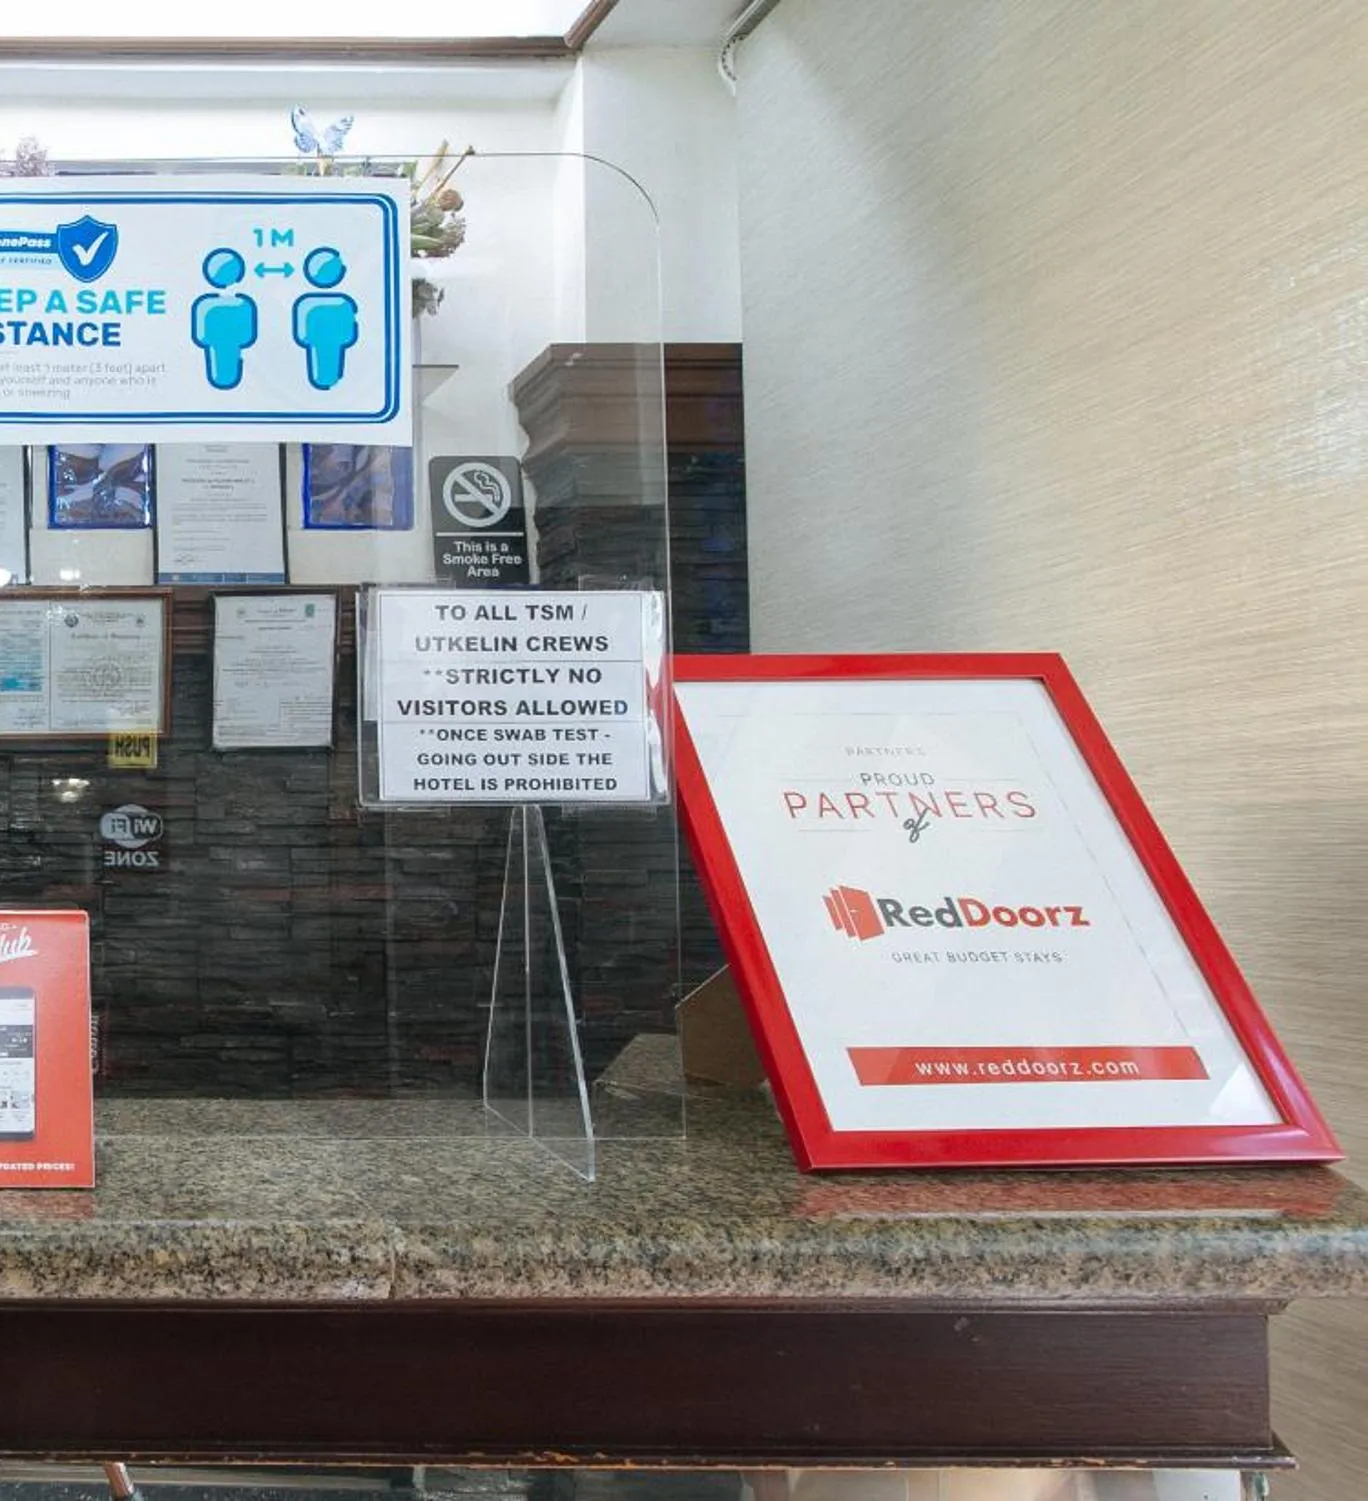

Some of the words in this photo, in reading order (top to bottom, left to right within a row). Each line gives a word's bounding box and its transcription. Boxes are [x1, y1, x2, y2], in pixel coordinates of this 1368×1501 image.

[45, 290, 68, 314] A
[75, 290, 166, 315] SAFE
[453, 541, 483, 552] This
[485, 541, 497, 552] is
[500, 543, 509, 552] a
[442, 553, 489, 565] Smoke
[492, 553, 522, 565] Free
[467, 566, 500, 577] Area
[435, 605, 466, 621] TO
[474, 605, 517, 621] ALL
[525, 605, 574, 621] TSM
[415, 636, 518, 652] UTKELIN
[526, 636, 609, 652] CREWS
[568, 668, 602, 684] NO
[397, 700, 508, 716] VISITORS
[515, 700, 629, 716] ALLOWED
[493, 728, 547, 742] SWAB
[554, 728, 599, 742] TEST
[417, 752, 478, 766] GOING
[483, 752, 522, 766] OUT
[528, 752, 570, 766] SIDE
[576, 752, 613, 766] THE
[413, 777, 475, 791] HOTEL
[480, 777, 498, 791] IS
[504, 777, 617, 791] PROHIBITED
[860, 772, 936, 787] PROUD
[783, 791, 1037, 819] PARTNERS
[876, 897, 1091, 928] RedDoorz
[892, 952, 940, 964] GREAT
[947, 952, 1008, 964] BUDGET
[1014, 952, 1064, 964] STAYS
[915, 1059, 1140, 1076] www.reddoorz.com
